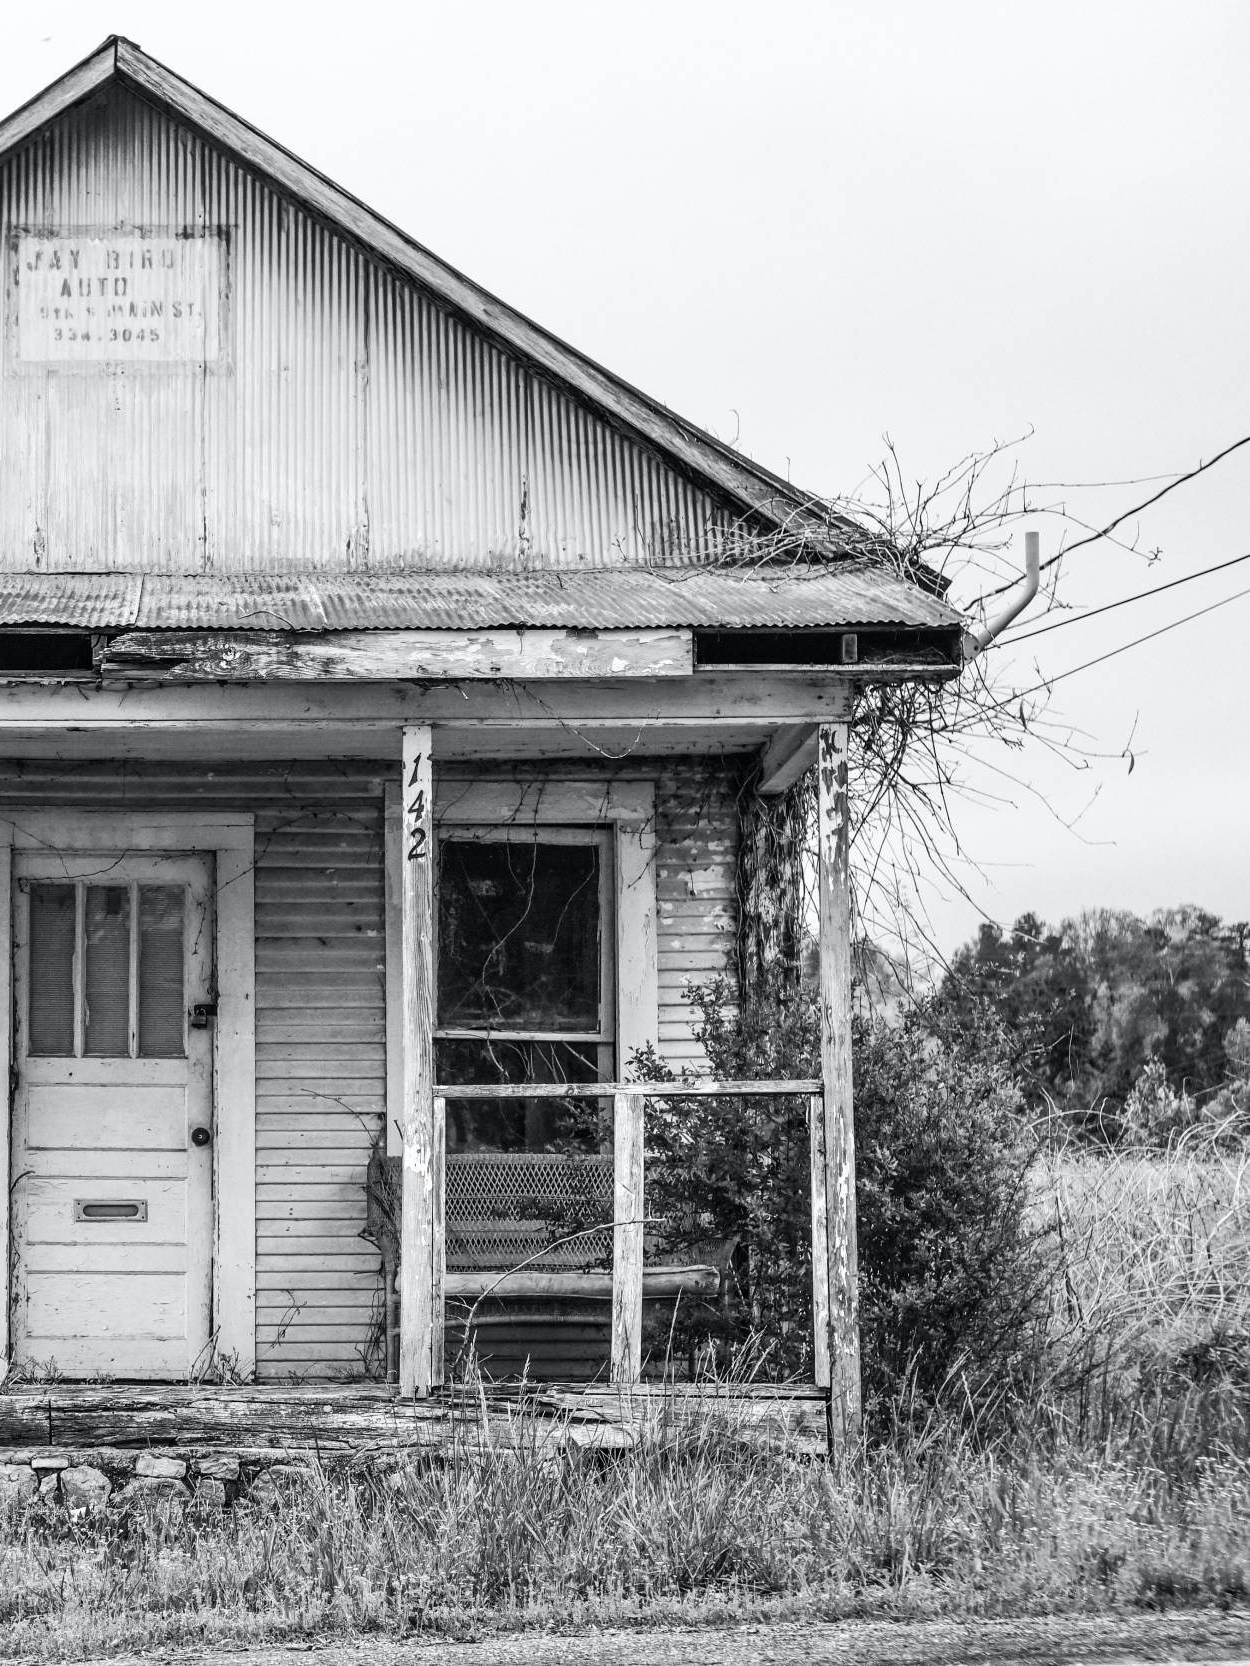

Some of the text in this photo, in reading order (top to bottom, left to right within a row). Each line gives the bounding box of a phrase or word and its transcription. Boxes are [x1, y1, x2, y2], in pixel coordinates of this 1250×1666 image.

[27, 249, 174, 271] JAY BIRD
[60, 277, 127, 297] AUTO
[408, 753, 426, 860] 142
